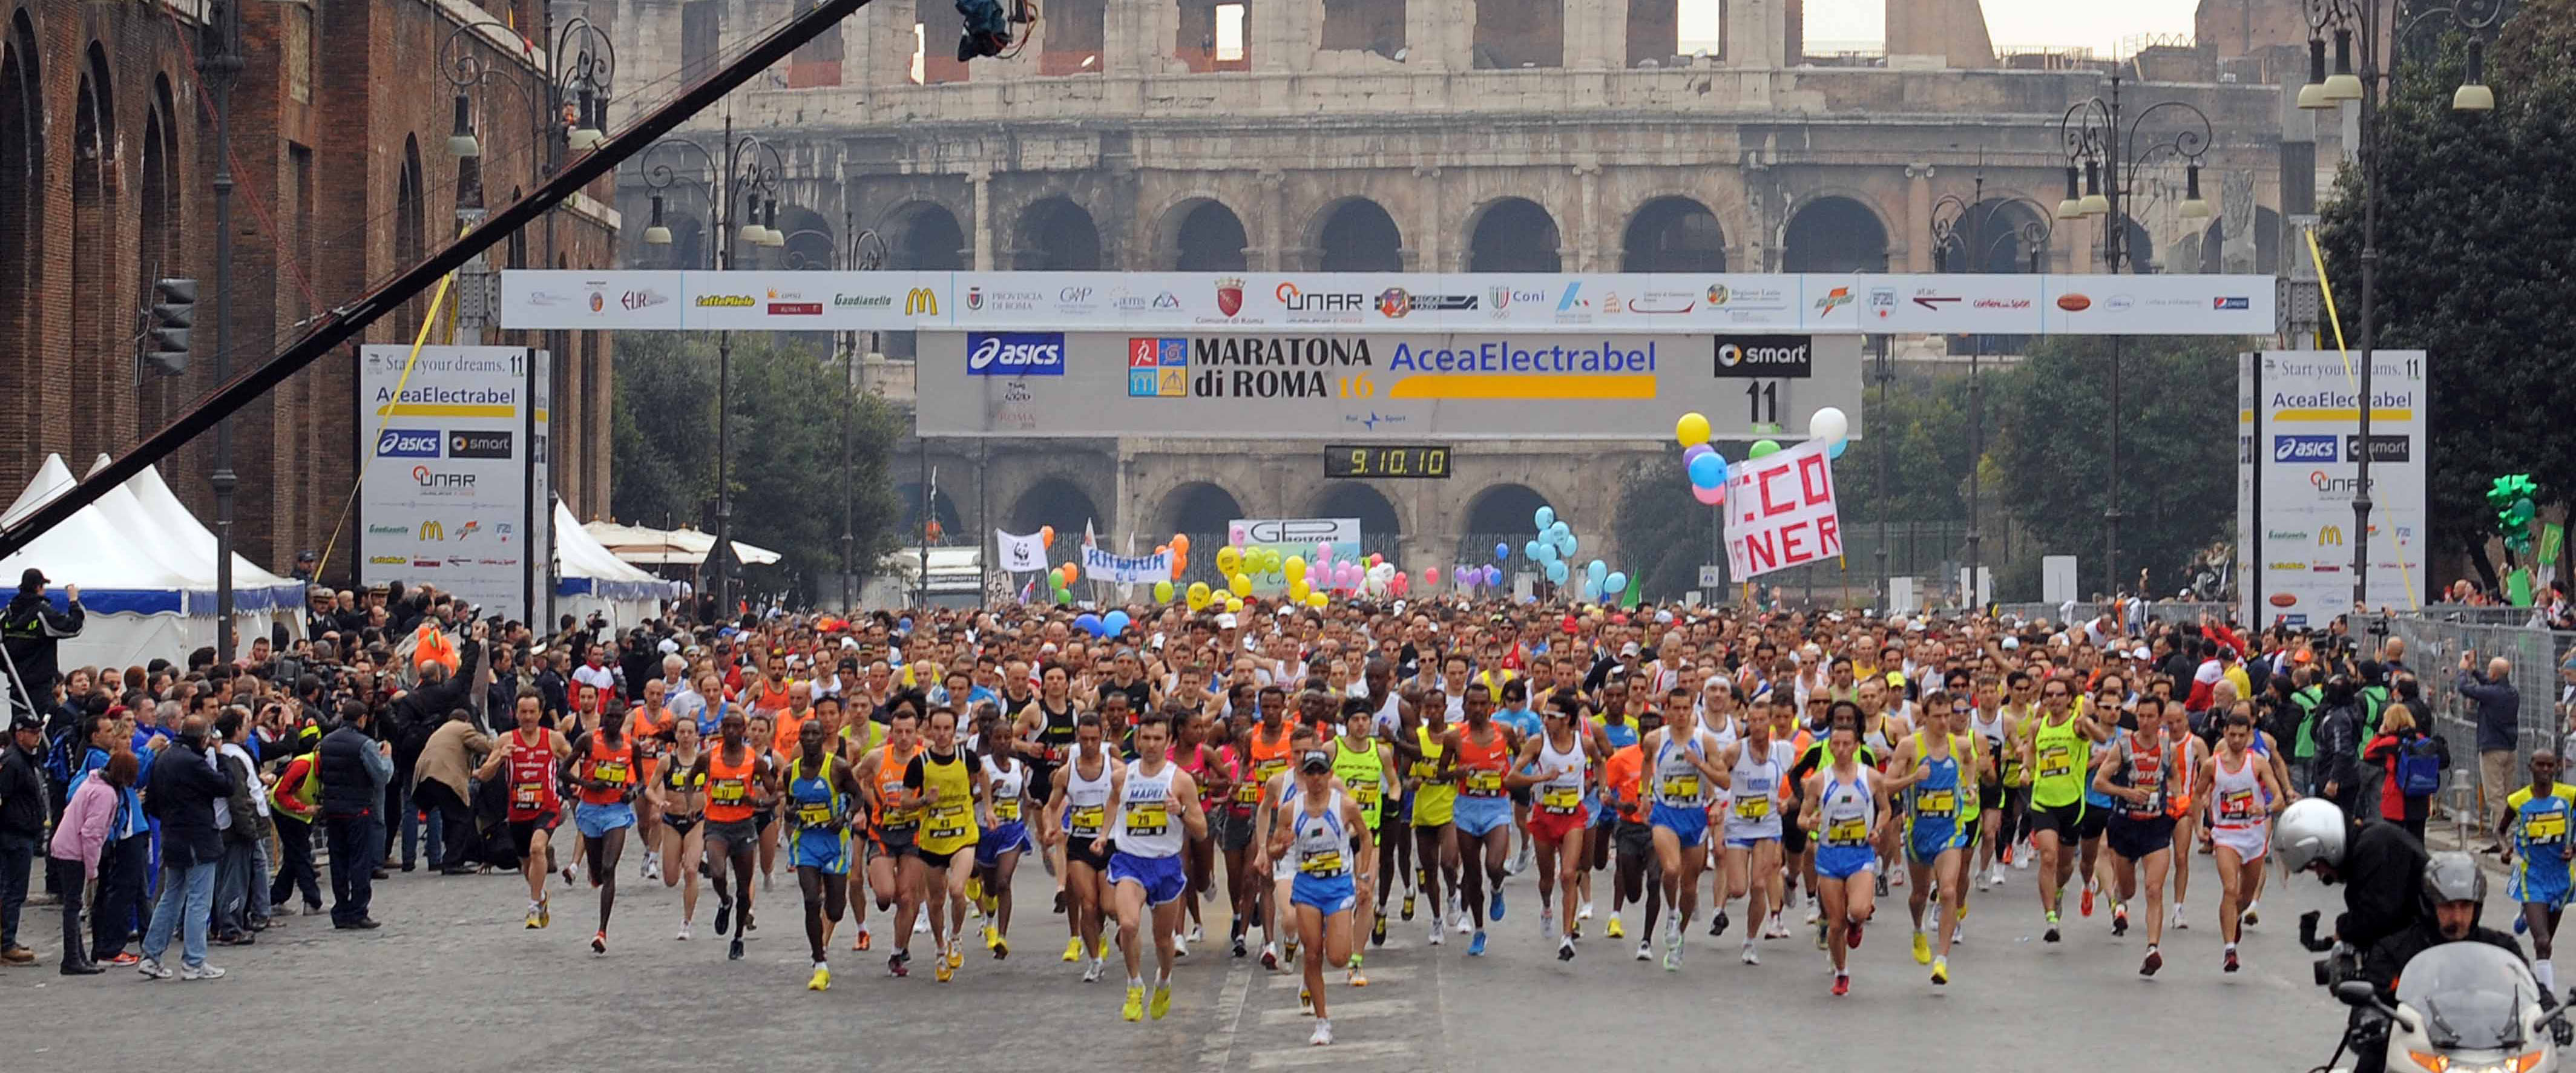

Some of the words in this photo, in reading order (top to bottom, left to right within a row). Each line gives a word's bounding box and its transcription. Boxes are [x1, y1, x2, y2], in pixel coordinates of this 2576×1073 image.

[621, 290, 646, 310] EUR
[1513, 290, 1544, 302] Coni
[1916, 287, 1937, 296] atac
[1287, 294, 1362, 311] UNAR
[1231, 316, 1239, 324] di
[1195, 338, 1372, 365] MARATONA
[1390, 341, 1655, 372] AceaElectrabel
[1746, 345, 1807, 363] smart
[387, 355, 417, 371] Stat
[422, 359, 452, 374] your
[455, 355, 505, 372] dreams.
[510, 355, 523, 375] 11
[2282, 361, 2312, 376] Start
[2351, 360, 2401, 376] dams.
[2407, 359, 2419, 378] 11
[1195, 370, 1223, 398] di
[1234, 371, 1327, 398] ROMA
[1338, 372, 1374, 399] 16
[1747, 381, 1778, 424] 11
[398, 436, 438, 451] asics
[470, 437, 509, 450] smart
[2295, 442, 2334, 456] asics
[421, 474, 475, 487] UNAR
[1130, 789, 1163, 798] MAPEI
